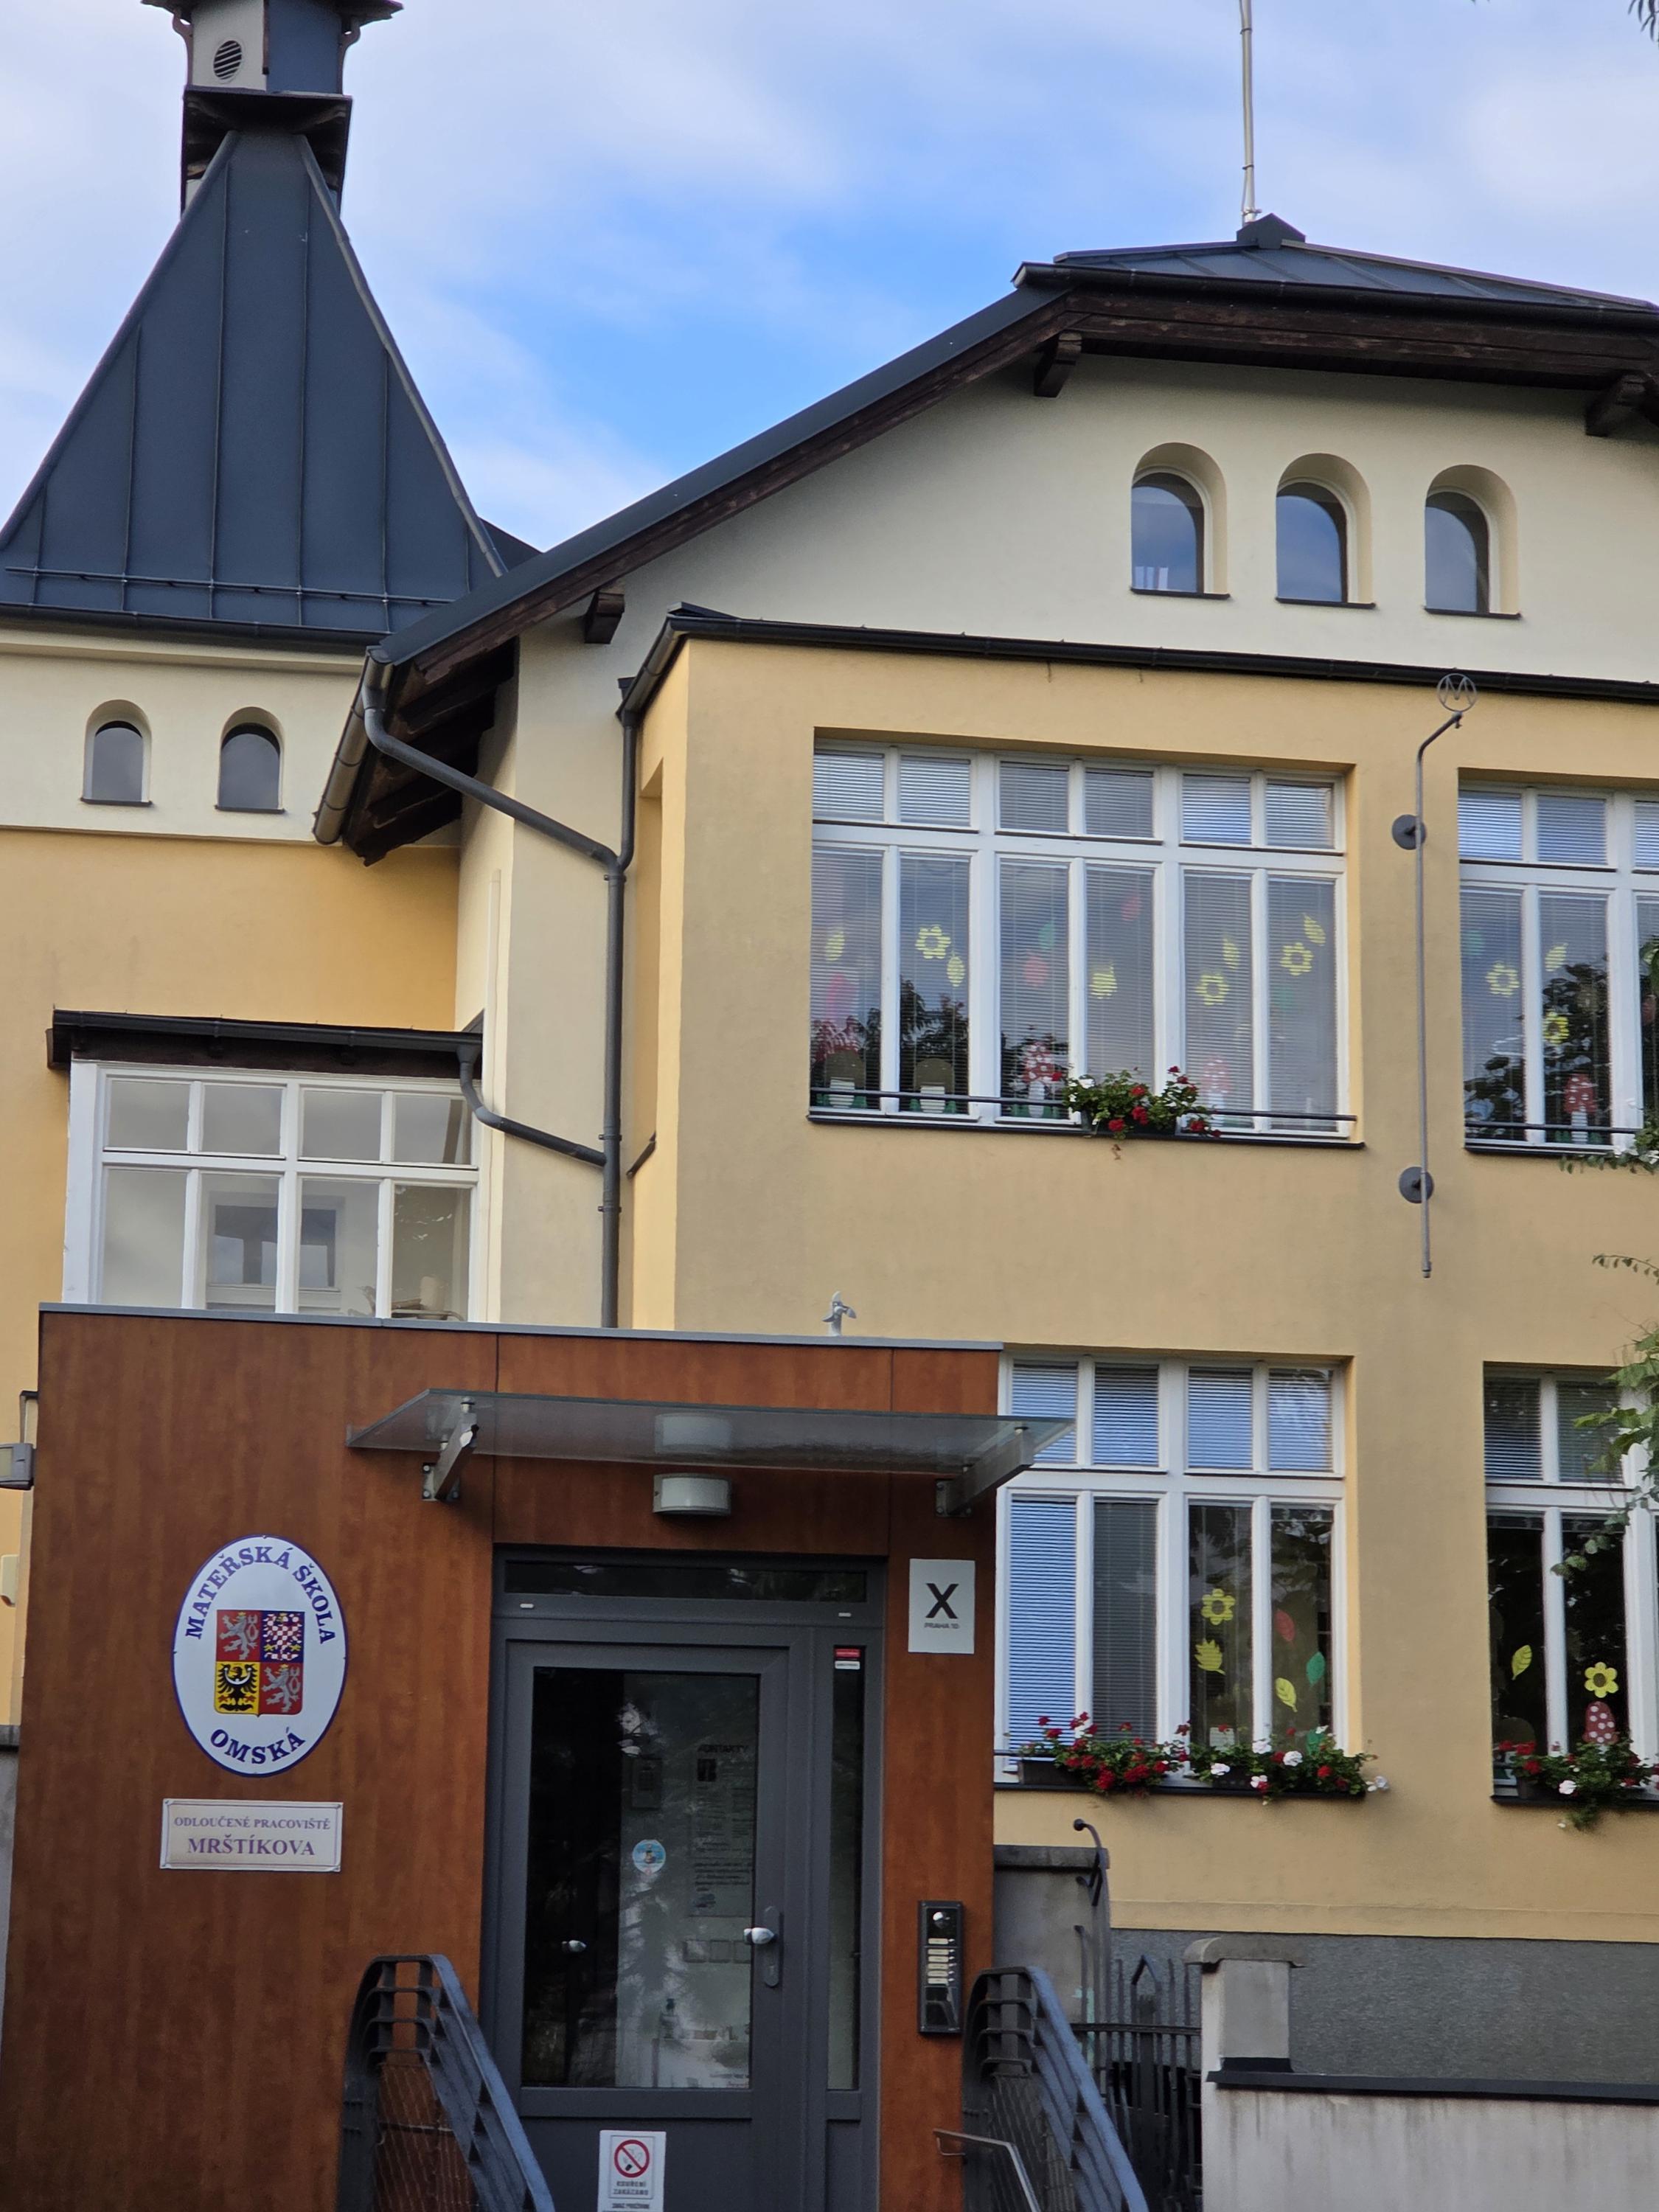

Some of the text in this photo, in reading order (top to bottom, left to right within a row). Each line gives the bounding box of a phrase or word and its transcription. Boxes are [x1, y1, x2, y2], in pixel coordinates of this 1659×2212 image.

[185, 1546, 336, 1644] MATEŘSKÁ ŠKOLA
[925, 1583, 959, 1619] X
[209, 1727, 305, 1764] OMSKÁ
[174, 1815, 251, 1829] ODLOUČENÉ
[187, 1834, 316, 1856] MRŠTÍKOVA
